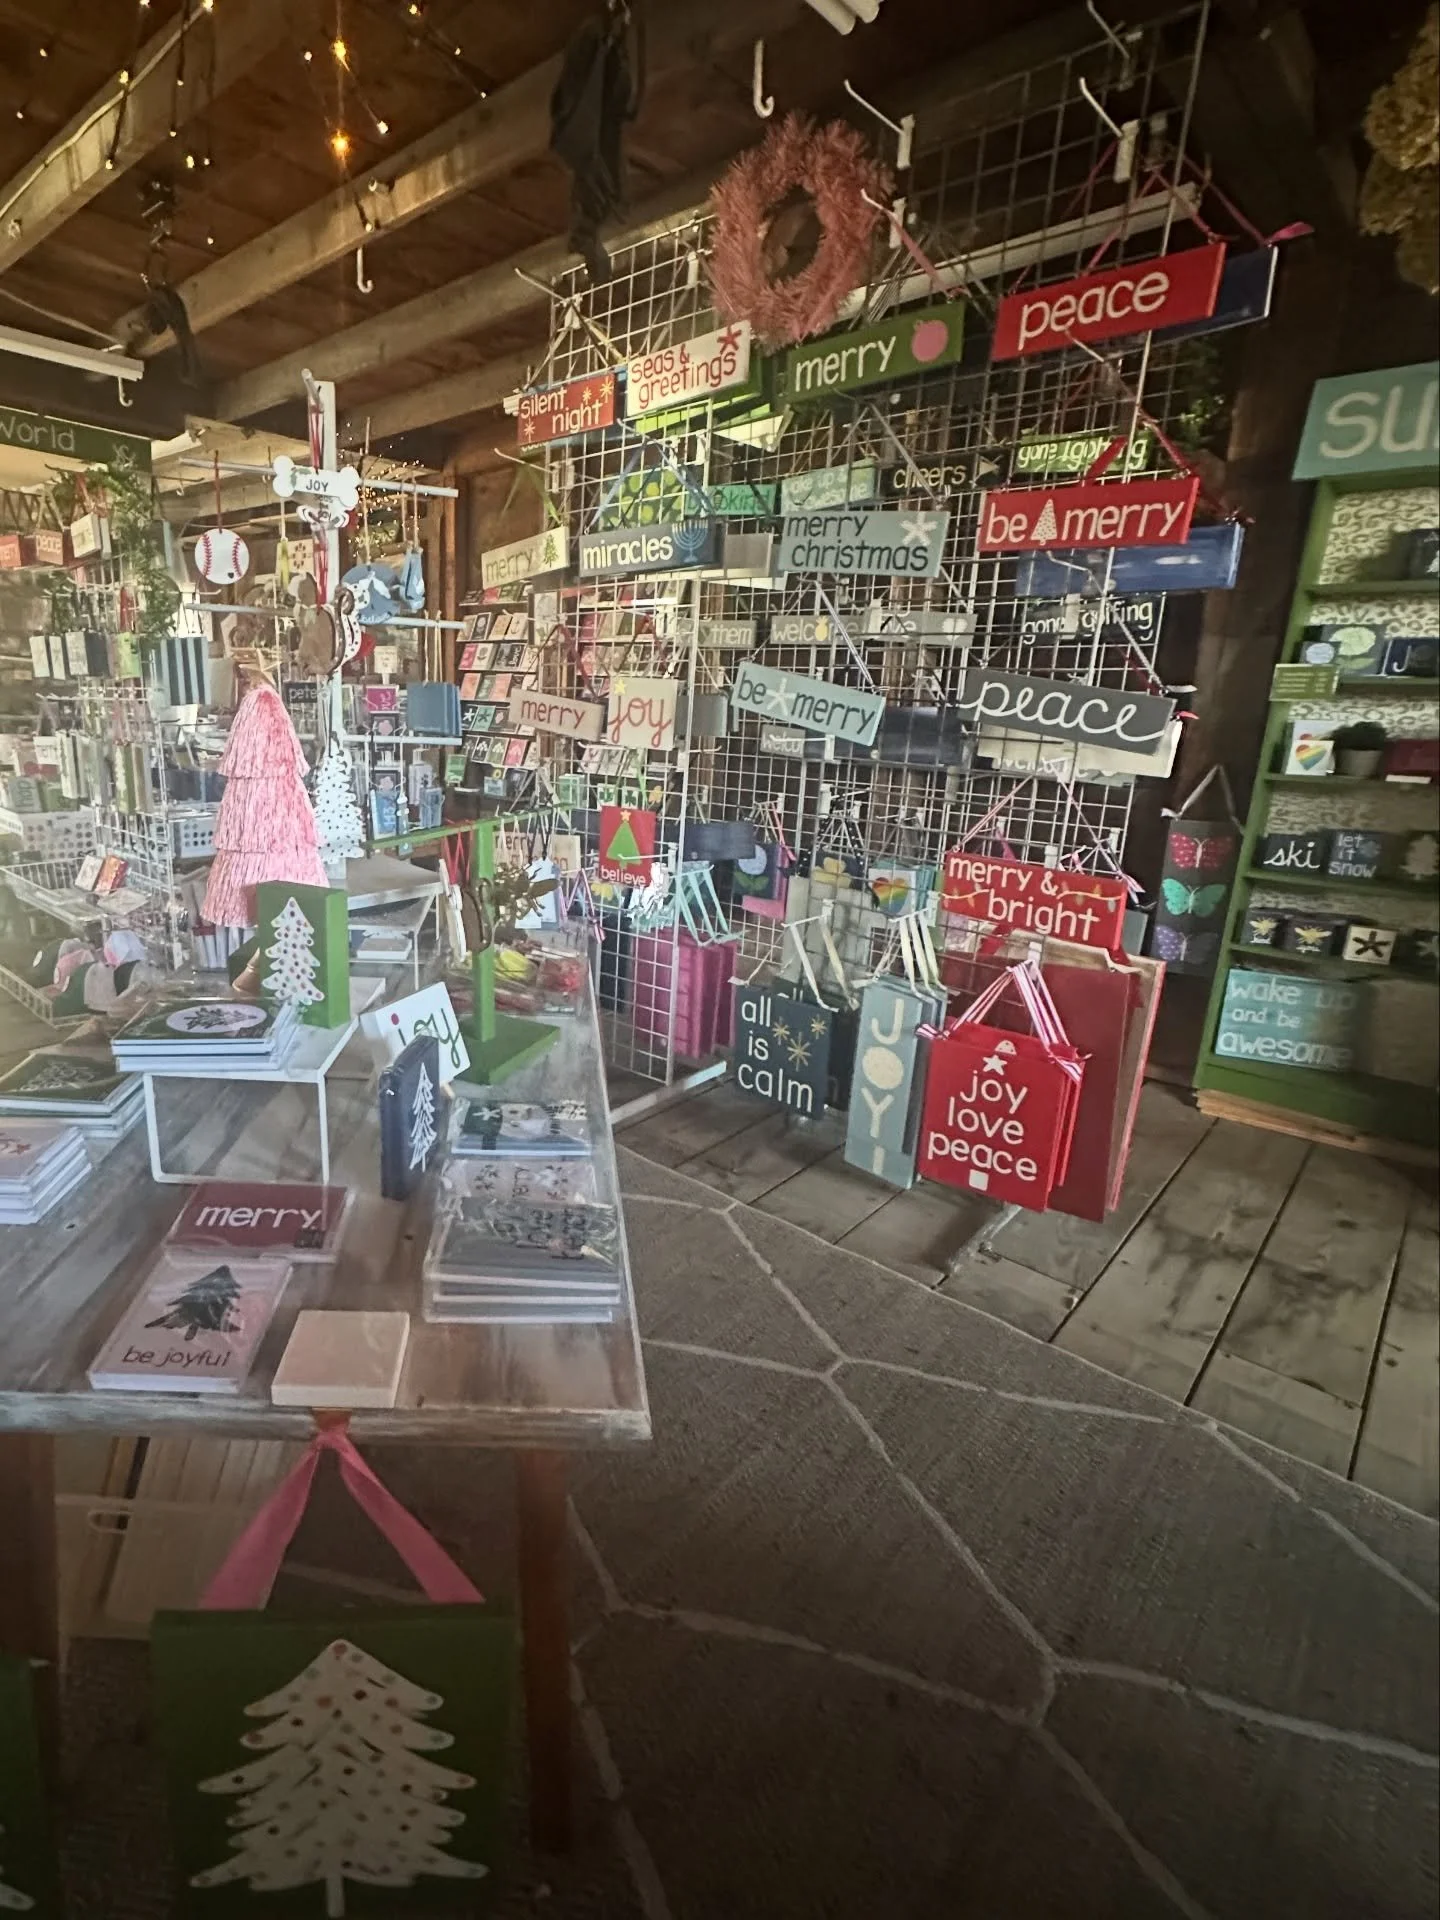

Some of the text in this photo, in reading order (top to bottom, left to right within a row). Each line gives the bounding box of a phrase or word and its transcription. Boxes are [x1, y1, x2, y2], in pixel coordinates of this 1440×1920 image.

[1017, 271, 1169, 351] peace
[631, 350, 675, 384] seas
[638, 351, 736, 410] greetings
[795, 336, 896, 392] merry
[520, 389, 567, 419] silent
[552, 402, 603, 435] night
[305, 479, 329, 492] JOY
[787, 515, 869, 537] merry
[985, 501, 1185, 544] be merry
[485, 546, 534, 582] merry
[583, 534, 673, 570] miracles
[791, 539, 929, 571] christmas
[521, 698, 585, 729] merry
[738, 671, 876, 735] be merry
[946, 681, 1165, 742] peace
[608, 694, 672, 748] joy
[1263, 841, 1321, 869] ski
[1337, 832, 1364, 848] let
[1338, 848, 1355, 861] it
[601, 865, 646, 885] believe
[949, 857, 1057, 896] merry &
[1329, 861, 1376, 878] snow
[988, 888, 1100, 941] bright
[1229, 976, 1301, 1005] wake
[741, 995, 771, 1027] all
[1232, 1006, 1302, 1028] and be
[747, 1030, 769, 1060] is
[1218, 1031, 1352, 1068] awesome
[738, 1063, 814, 1113] calm
[960, 1070, 1028, 1115] joy
[948, 1097, 1024, 1145] love
[928, 1131, 1038, 1182] peace
[195, 1205, 323, 1229] merry
[121, 1347, 231, 1369] be joyful
